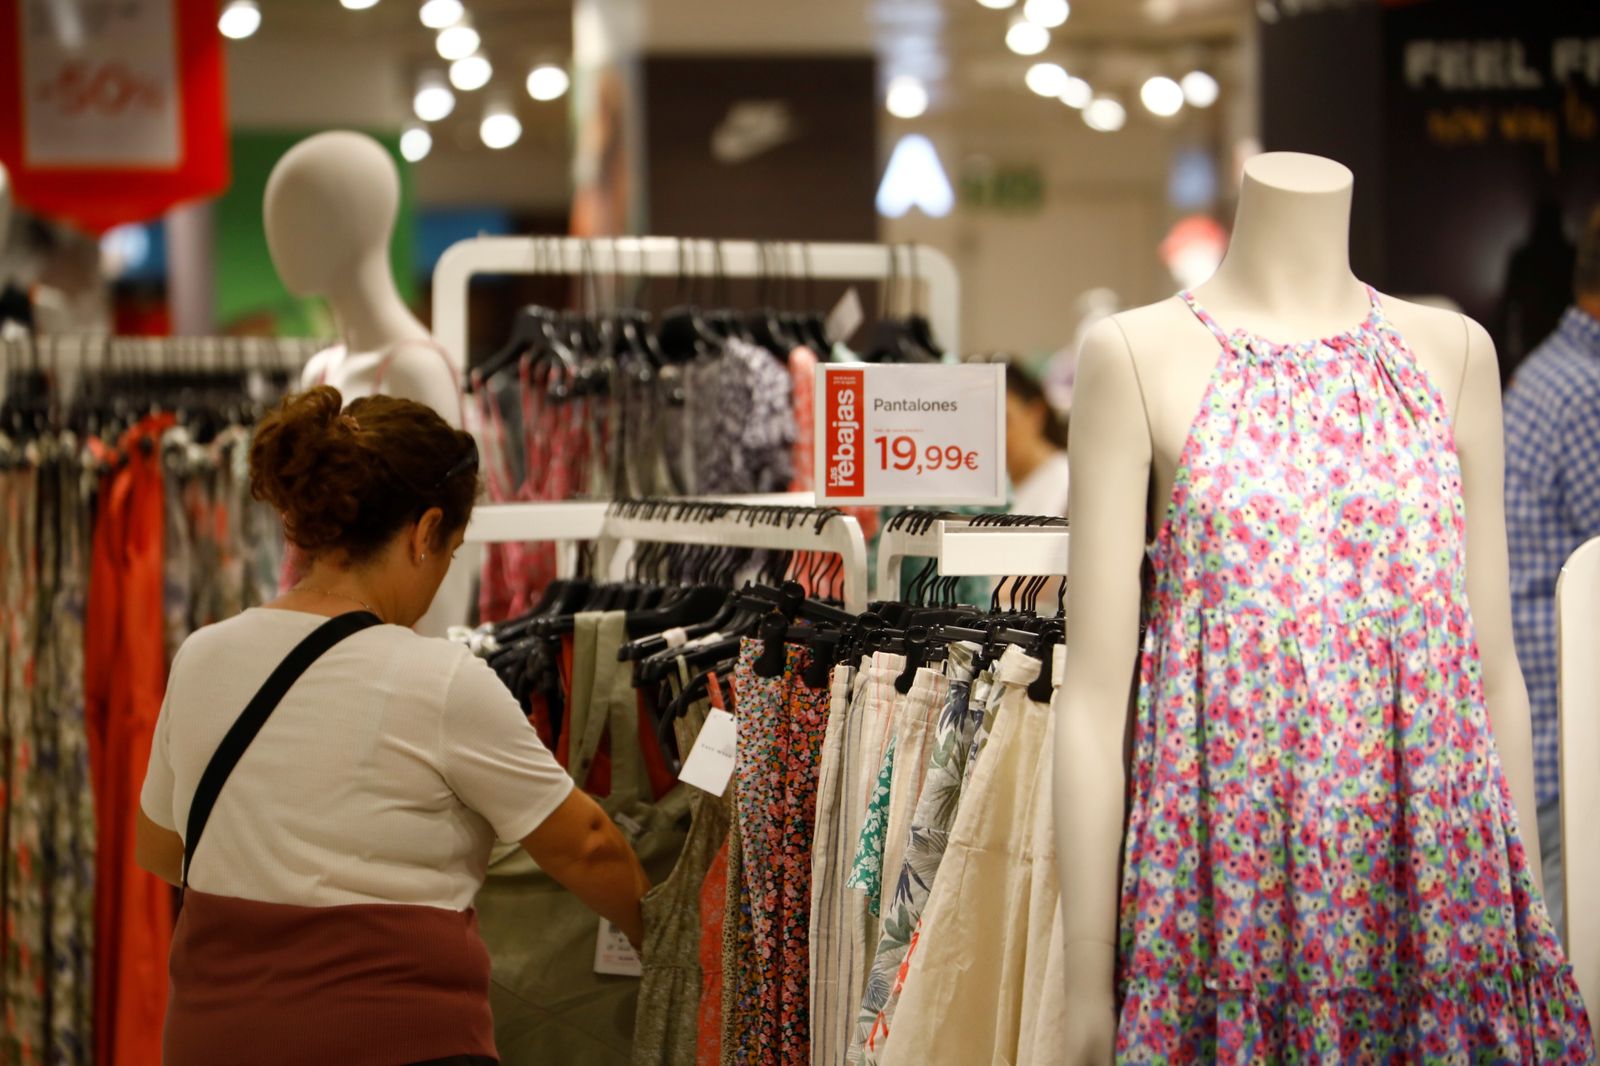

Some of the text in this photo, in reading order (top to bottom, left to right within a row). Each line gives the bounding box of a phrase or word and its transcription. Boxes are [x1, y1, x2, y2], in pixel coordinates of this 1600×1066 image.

[873, 397, 958, 412] Pantalones
[832, 388, 859, 487] rebajas
[874, 435, 979, 476] 19,99€
